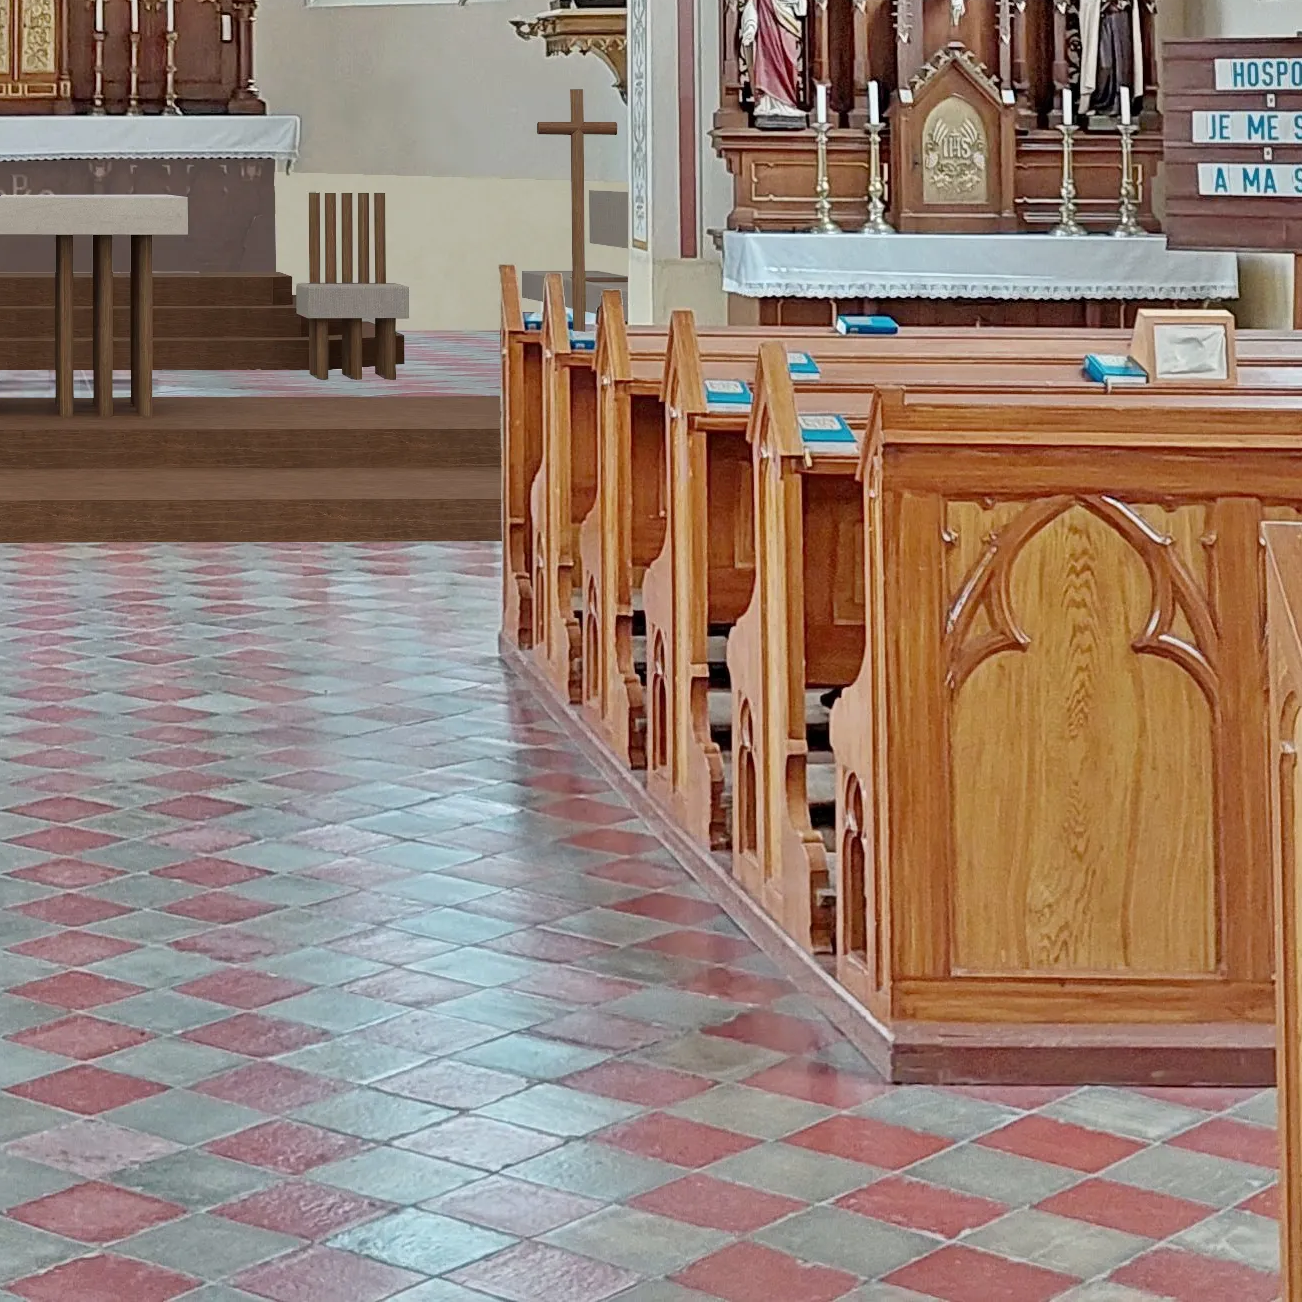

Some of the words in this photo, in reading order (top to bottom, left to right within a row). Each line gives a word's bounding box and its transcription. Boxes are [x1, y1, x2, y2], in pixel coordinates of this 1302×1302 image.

[1232, 60, 1302, 87] HOSPO
[1208, 114, 1231, 140] JE
[1247, 114, 1280, 141] ME
[943, 136, 972, 158] IHS
[1214, 167, 1228, 193] A
[1242, 167, 1278, 194] MA
